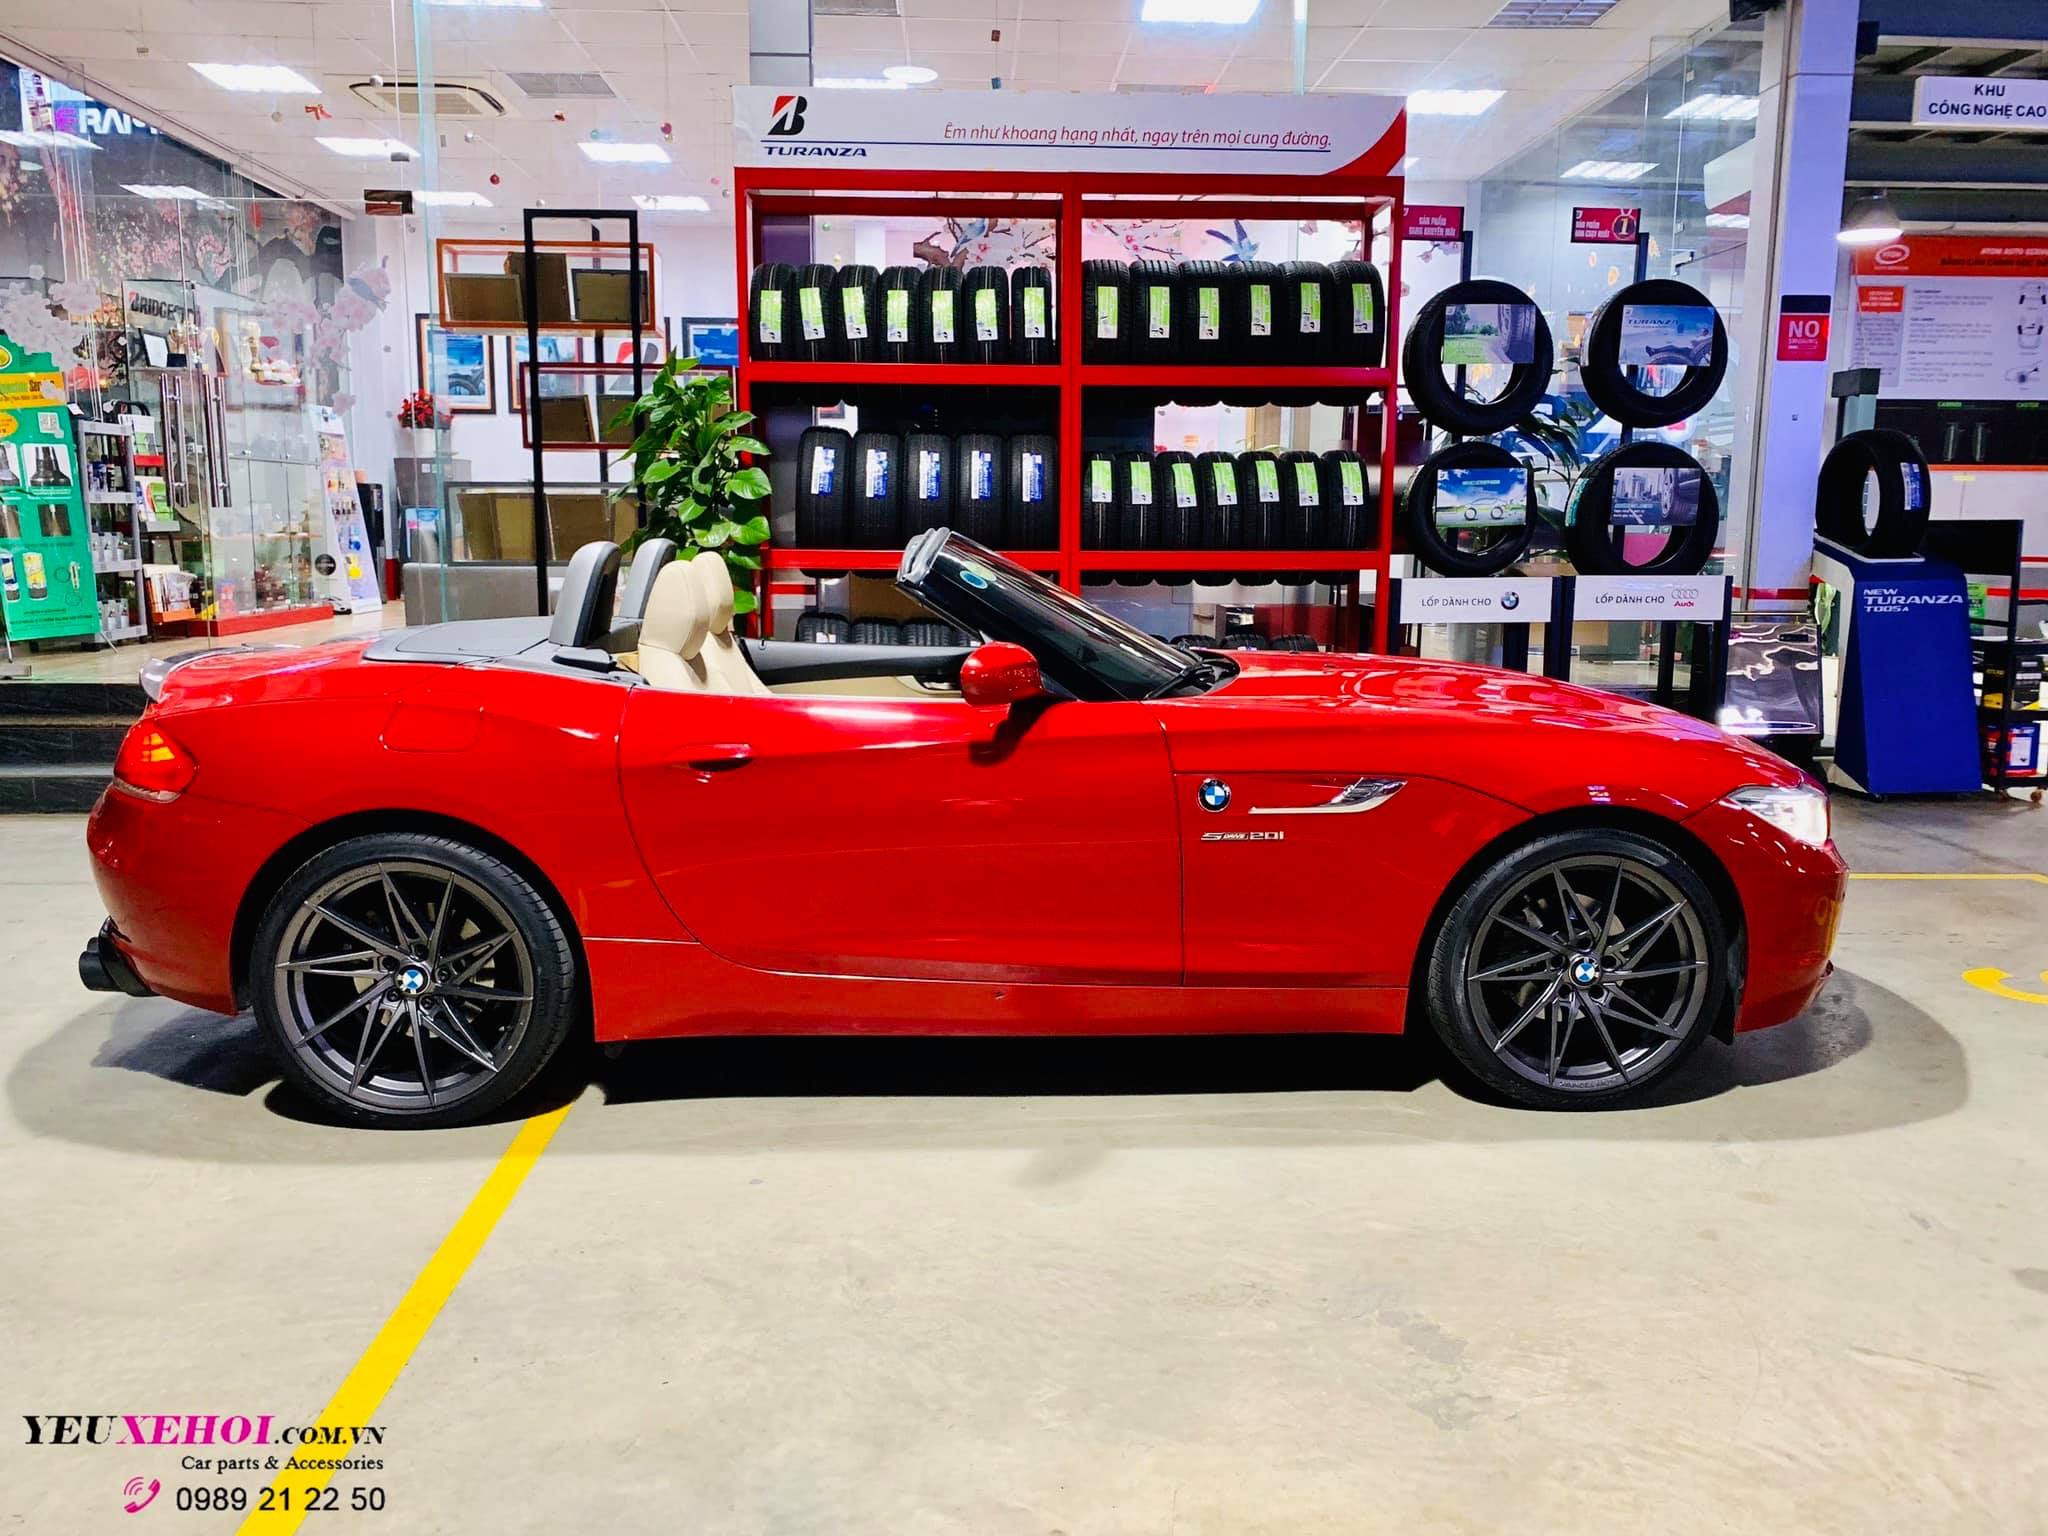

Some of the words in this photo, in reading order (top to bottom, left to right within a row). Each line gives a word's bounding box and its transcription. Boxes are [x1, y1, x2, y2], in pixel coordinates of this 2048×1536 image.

[1974, 84, 2006, 97] KHU
[1973, 102, 2013, 119] NGHỆ
[2015, 104, 2047, 118] CAO
[943, 121, 967, 140] Êm
[970, 124, 1000, 141] như
[1002, 124, 1057, 145] khoang
[1060, 125, 1098, 146] hạng
[1101, 126, 1139, 144] nhất,
[1142, 130, 1178, 147] ngay
[1181, 128, 1210, 144] trên
[1213, 129, 1241, 148] mọi
[1243, 133, 1280, 149] cung
[1282, 130, 1332, 150] đường.
[763, 146, 868, 157] TURANZA
[1788, 320, 1820, 338] NO
[1863, 588, 1898, 596] NEW
[1442, 596, 1469, 607] DÀNH
[1471, 597, 1492, 606] CHO
[1615, 594, 1643, 604] DÀNH
[1644, 595, 1665, 604] CHO
[1673, 600, 1695, 608] Audi
[1863, 595, 1964, 605] TURANZA
